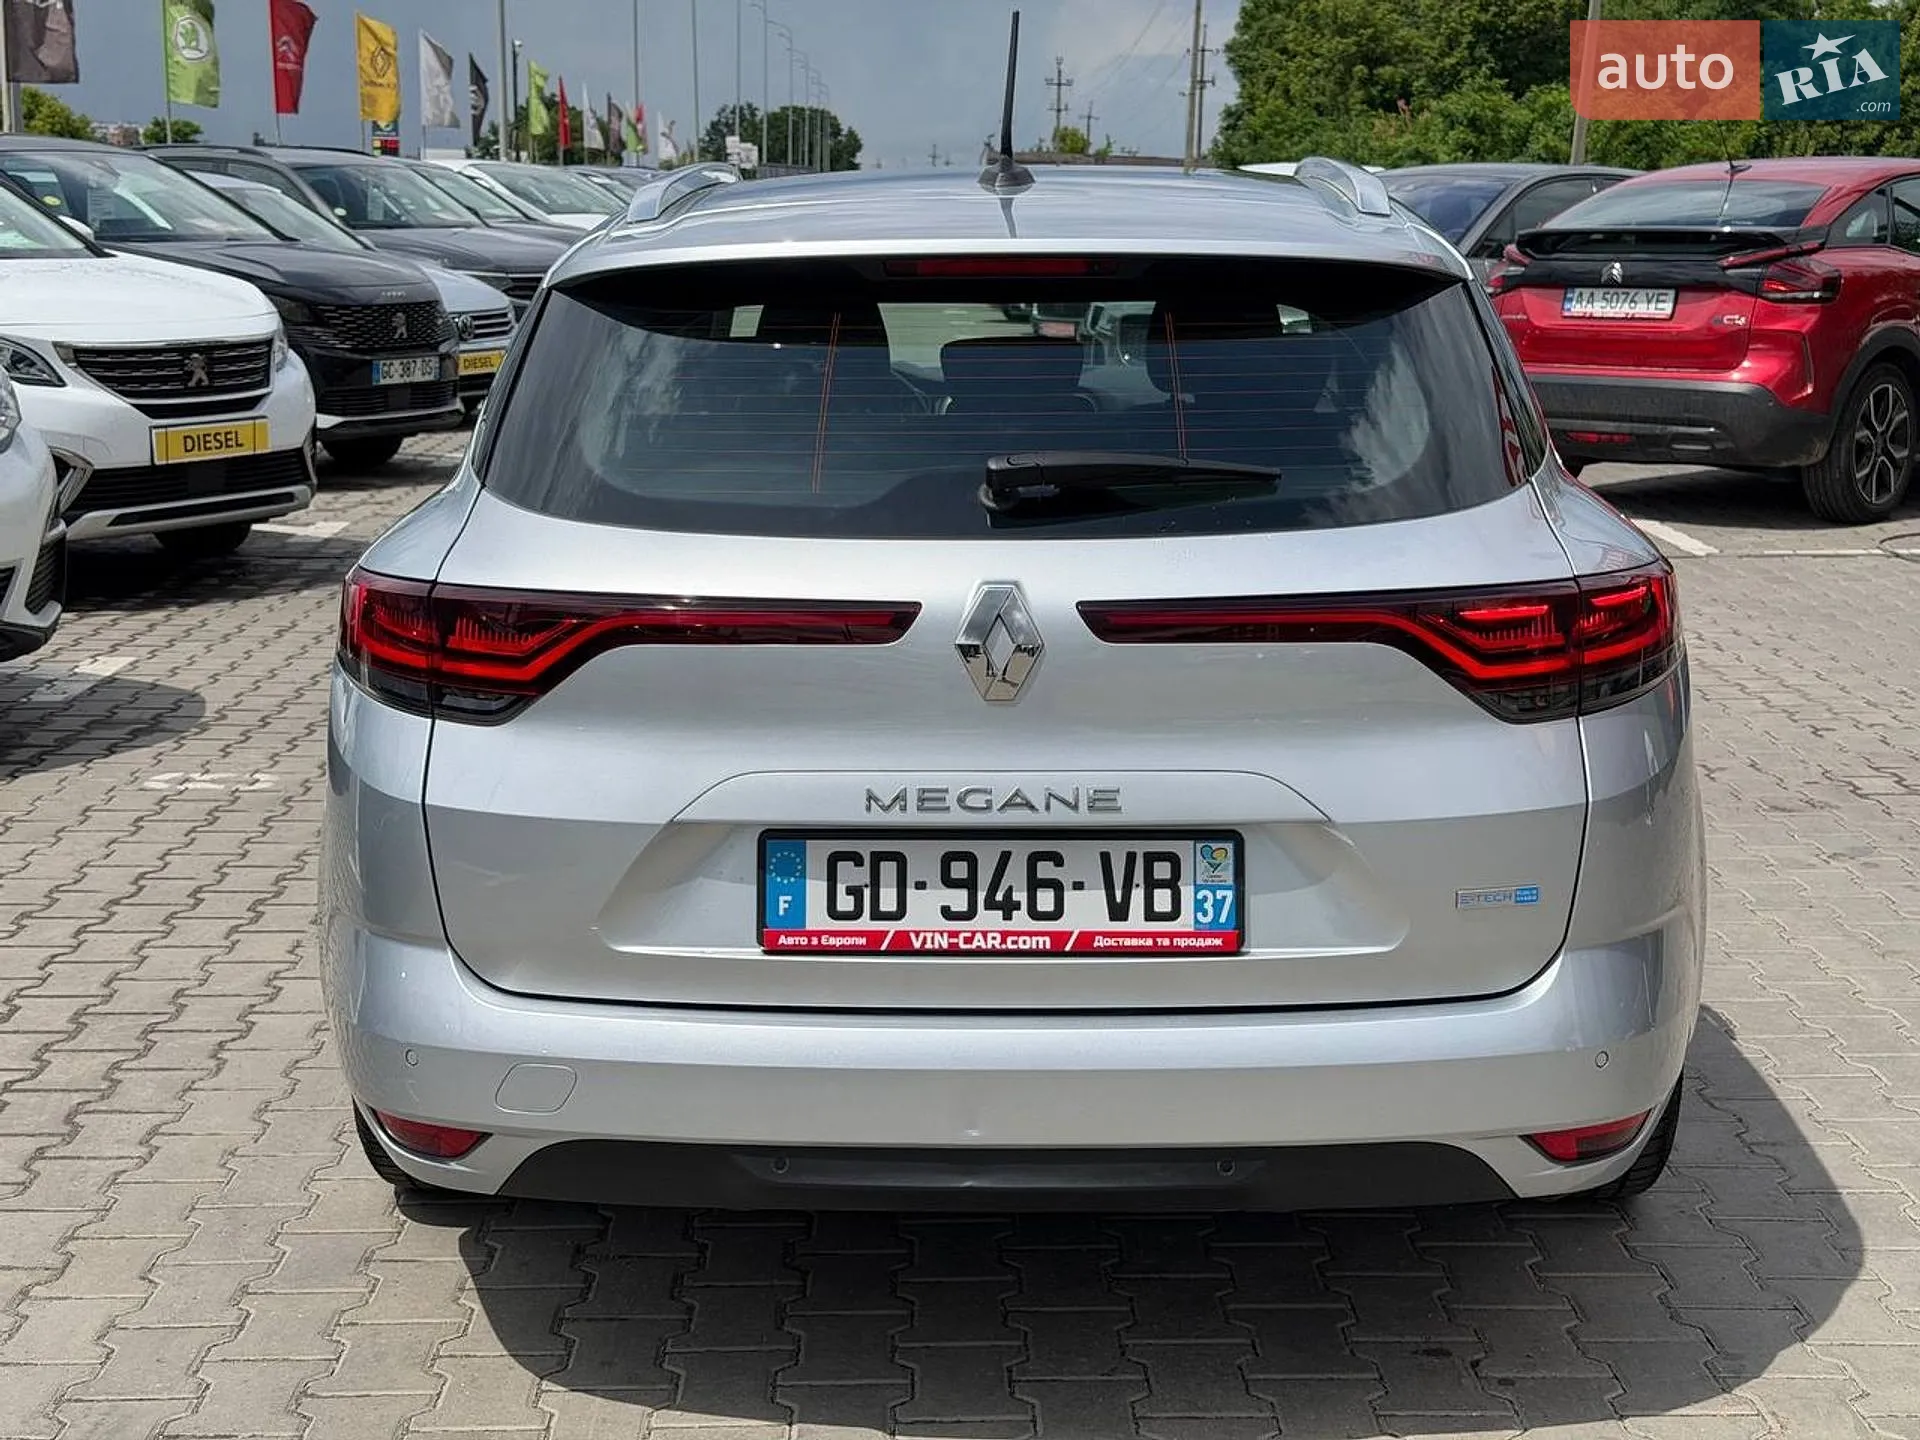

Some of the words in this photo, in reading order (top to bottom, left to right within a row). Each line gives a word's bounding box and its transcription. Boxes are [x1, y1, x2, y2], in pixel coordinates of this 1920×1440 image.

[1573, 290, 1595, 309] AA
[1600, 291, 1638, 310] 5076
[1645, 292, 1668, 311] YE
[463, 357, 494, 371] DIESEL
[183, 430, 245, 454] DIESEL
[864, 786, 1123, 814] MEGANE
[826, 850, 1182, 922] GD-946-VB
[778, 895, 792, 915] F
[1196, 889, 1233, 924] 37
[777, 934, 809, 946] Авто
[909, 932, 1051, 950] VIN-CAR.com
[1093, 935, 1153, 948] Доставка
[1156, 937, 1170, 947] та
[1173, 937, 1223, 949] продаж
